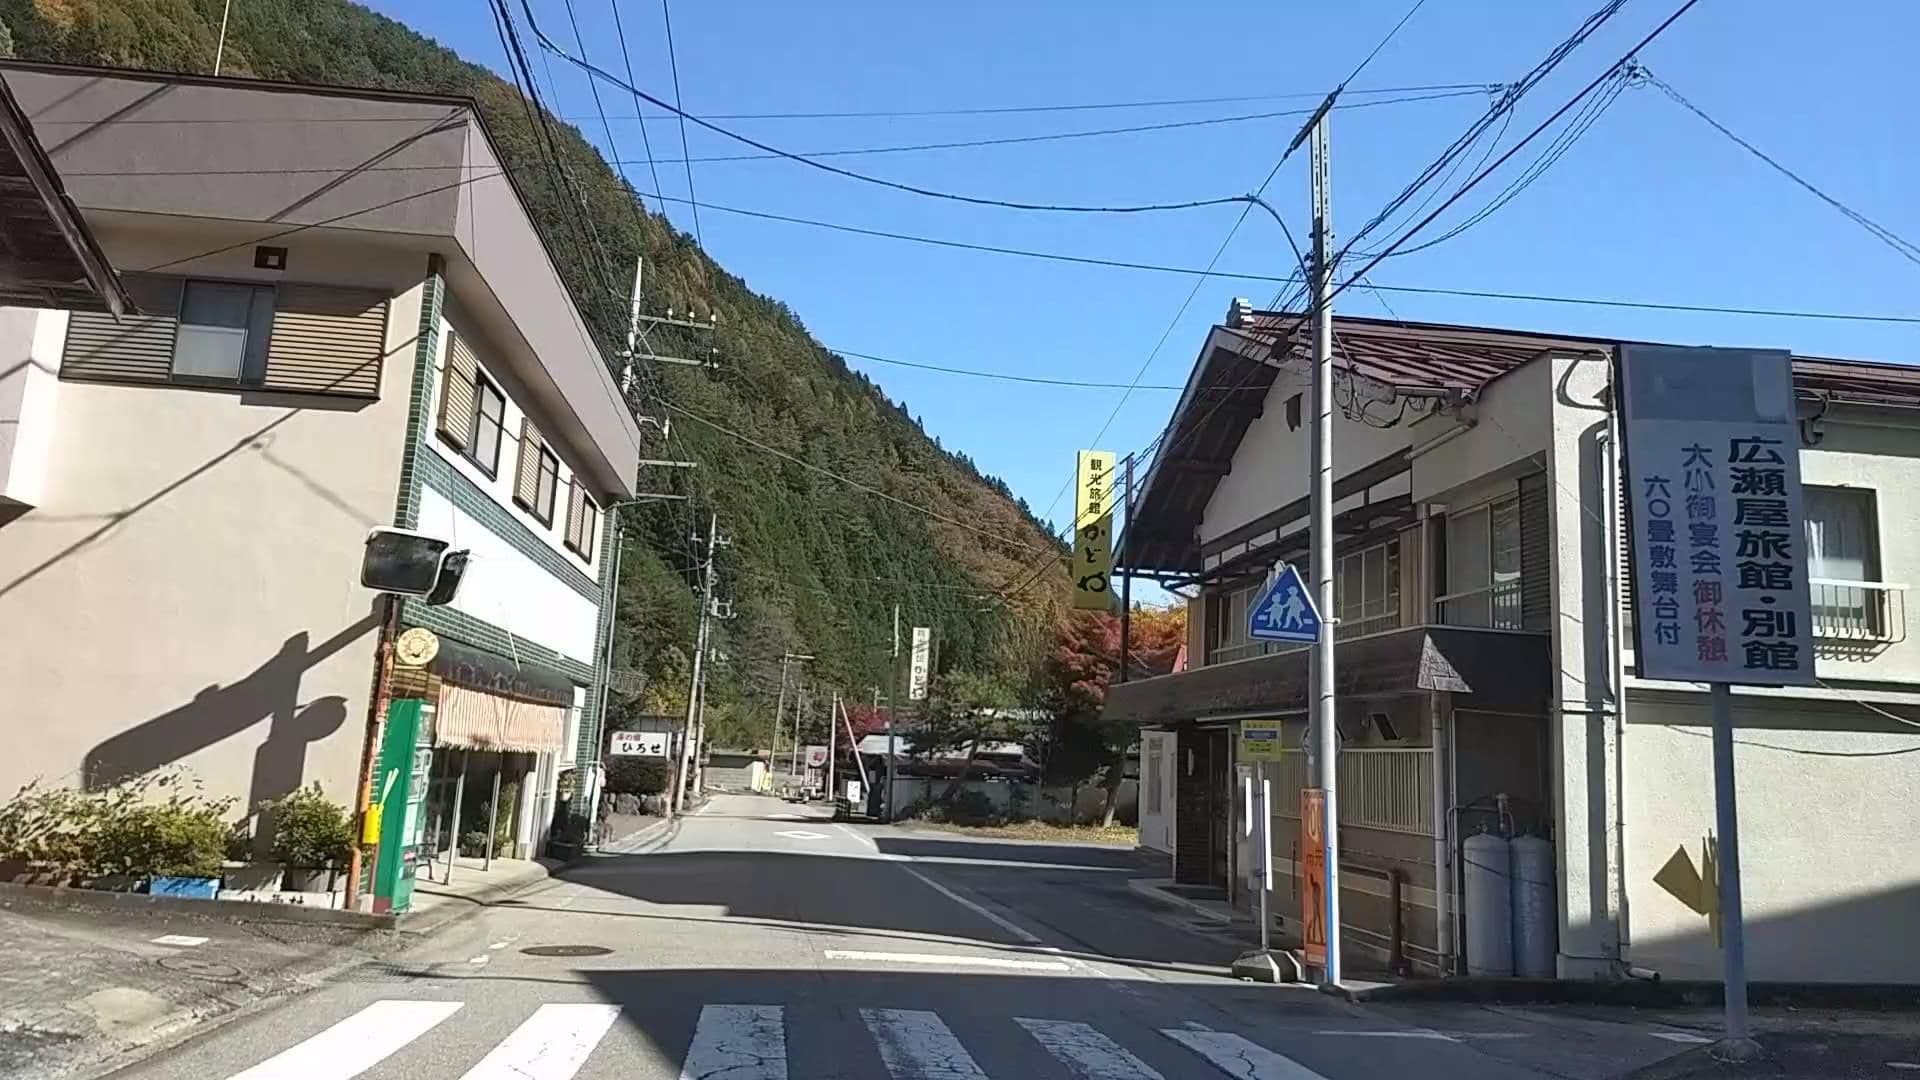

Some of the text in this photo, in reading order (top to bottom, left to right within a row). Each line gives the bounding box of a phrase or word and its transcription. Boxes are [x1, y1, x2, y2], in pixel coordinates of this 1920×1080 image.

[1727, 436, 1799, 670] 広瀬屋旅館・別館
[622, 742, 661, 754] ひろせ
